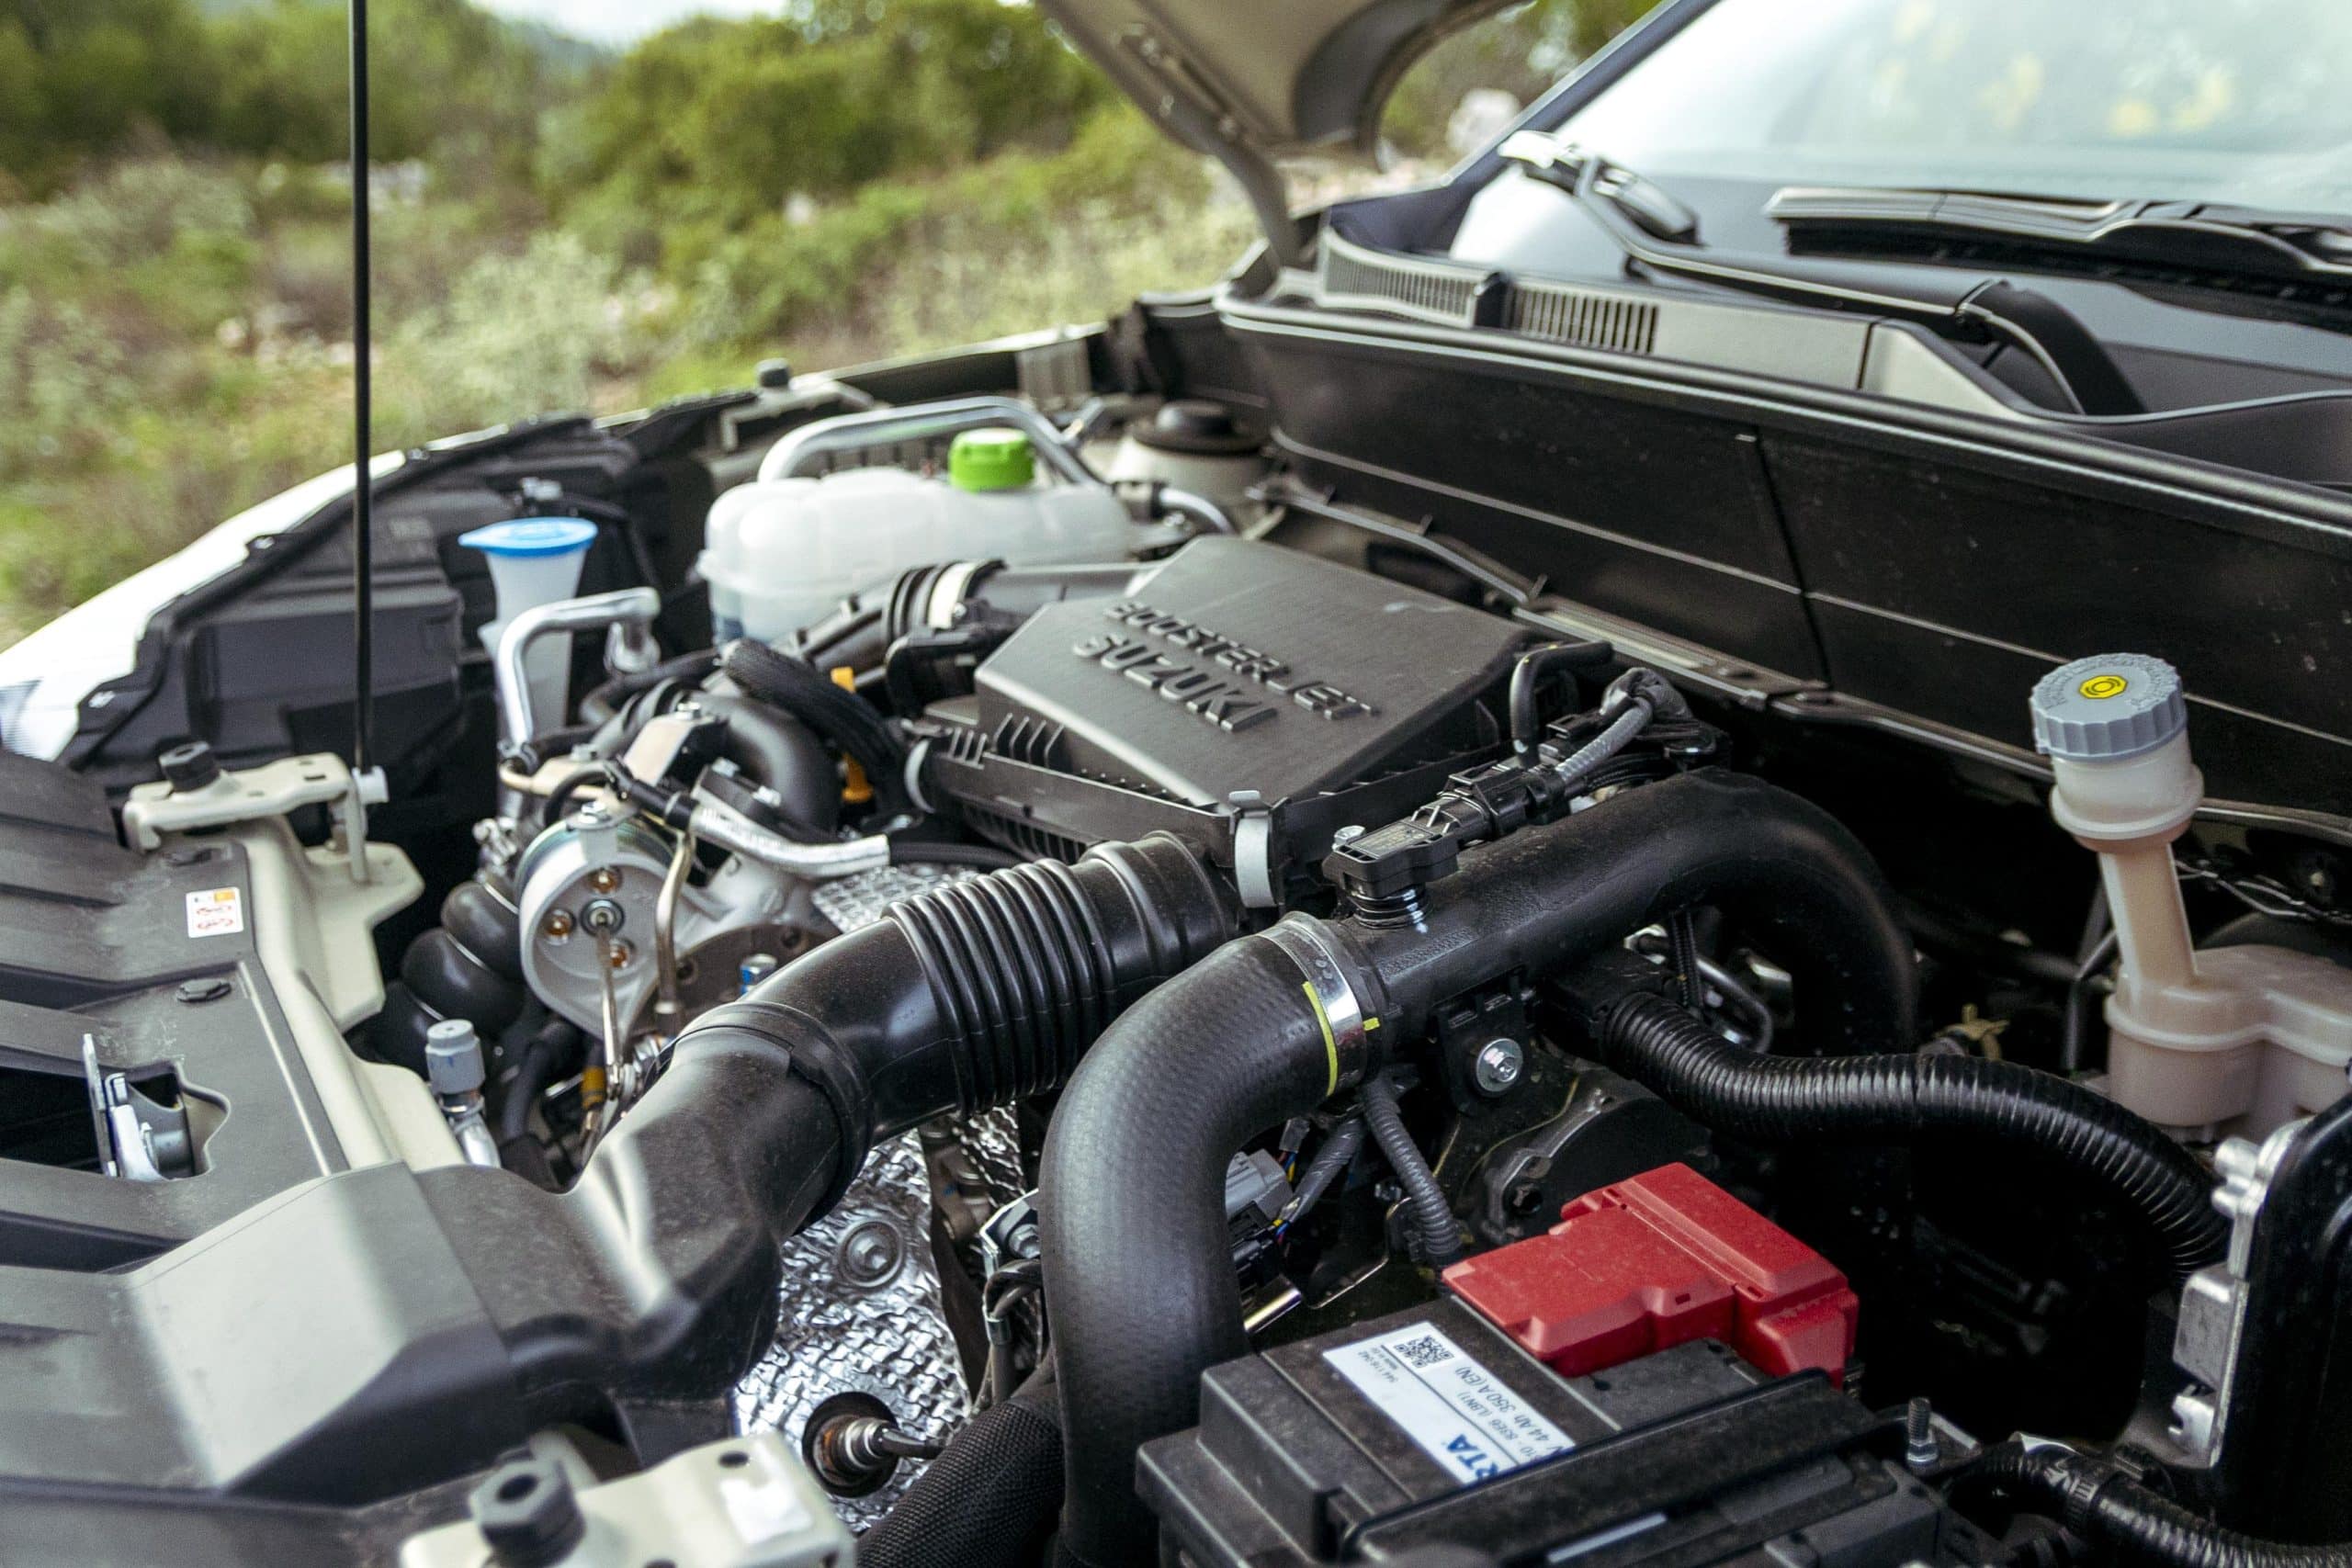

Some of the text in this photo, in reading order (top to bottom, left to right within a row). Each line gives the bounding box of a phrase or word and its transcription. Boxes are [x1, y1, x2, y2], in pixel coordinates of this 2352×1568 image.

[1073, 632, 1278, 732] SUZUKI
[1103, 601, 1380, 721] BOOSTERJET
[1486, 1393, 1517, 1414] 350
